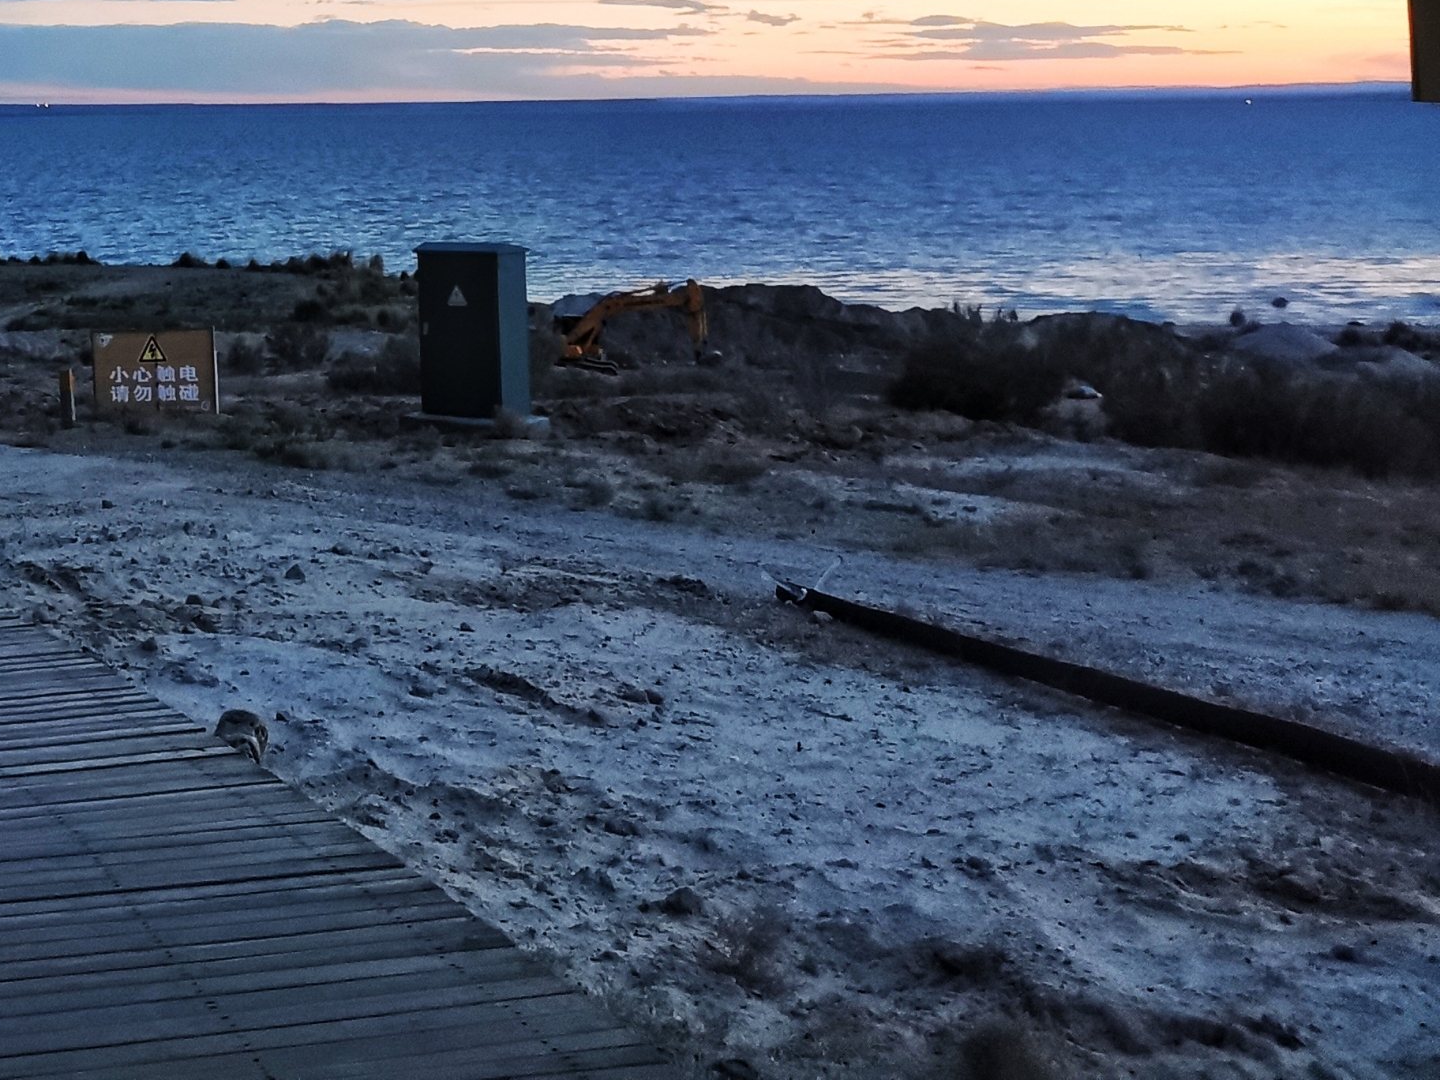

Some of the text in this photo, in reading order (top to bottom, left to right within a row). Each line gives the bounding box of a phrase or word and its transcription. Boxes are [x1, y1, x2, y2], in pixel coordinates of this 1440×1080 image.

[109, 365, 199, 383] 小心触电
[110, 384, 200, 402] 请勿触碰
